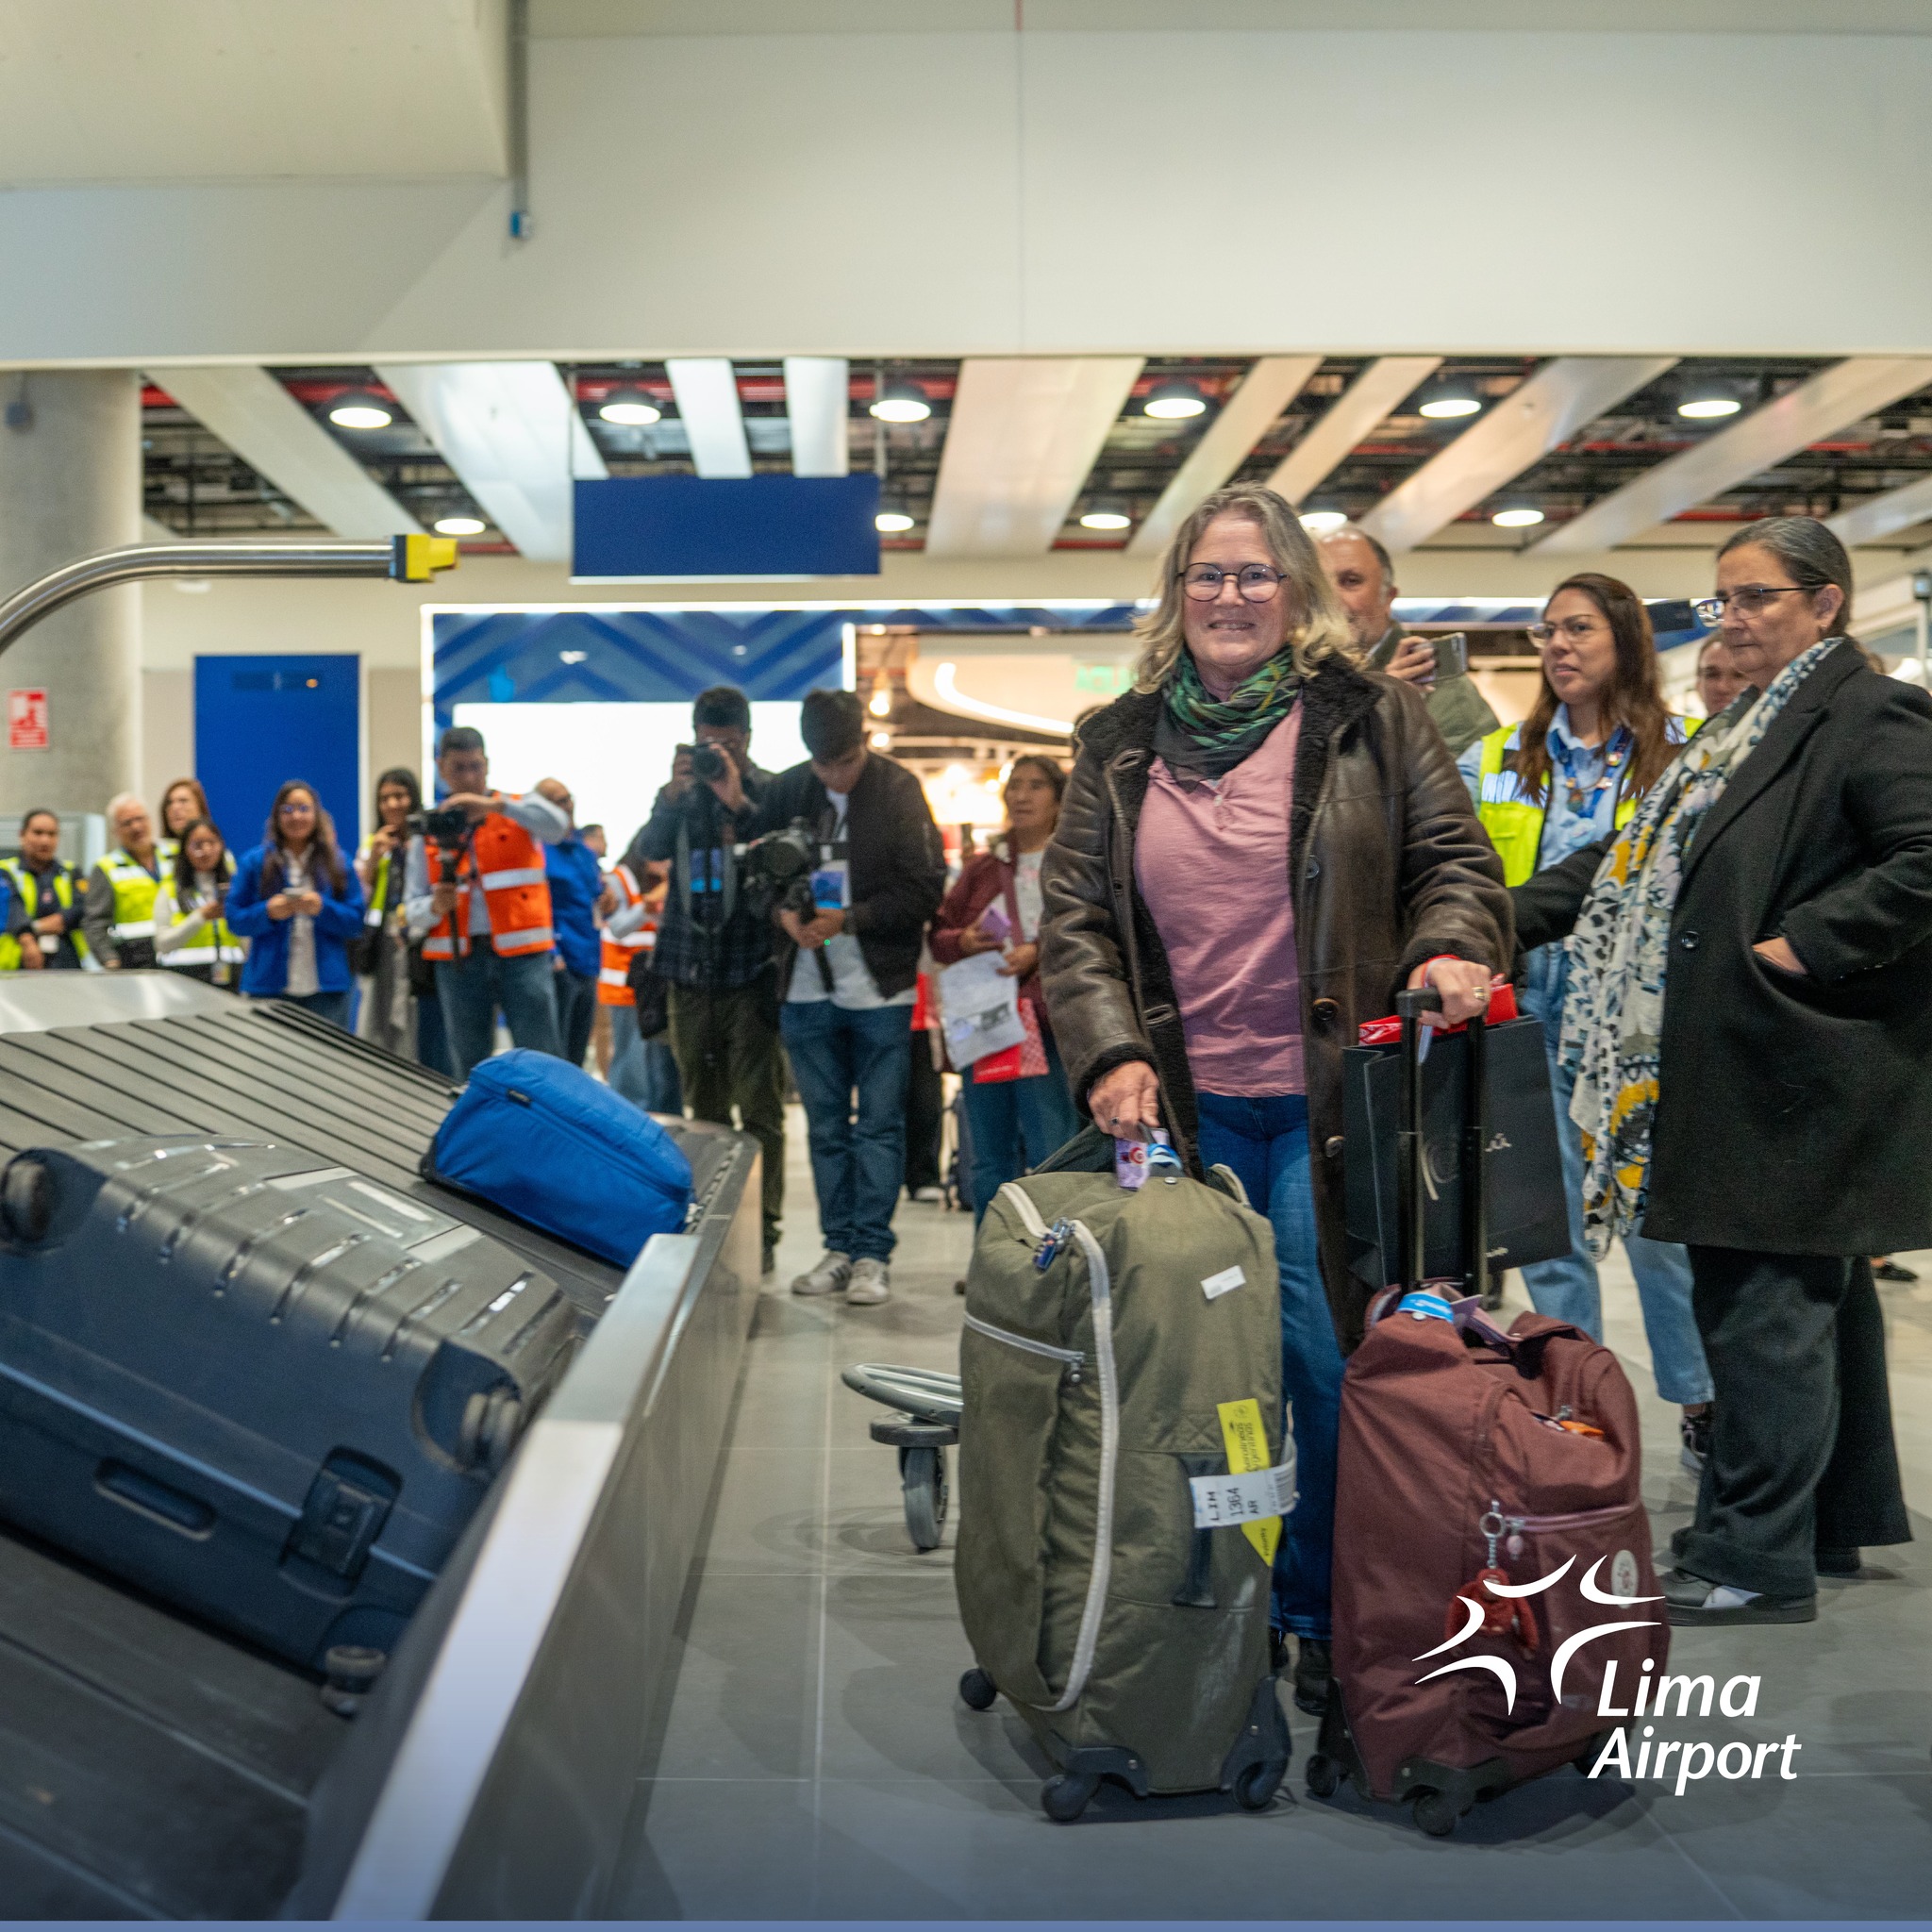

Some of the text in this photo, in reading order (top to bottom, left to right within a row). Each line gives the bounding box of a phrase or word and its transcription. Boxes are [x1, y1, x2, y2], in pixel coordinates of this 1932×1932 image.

[1207, 1491, 1220, 1521] LIM
[1225, 1487, 1244, 1517] 1364
[1247, 1500, 1259, 1514] AR
